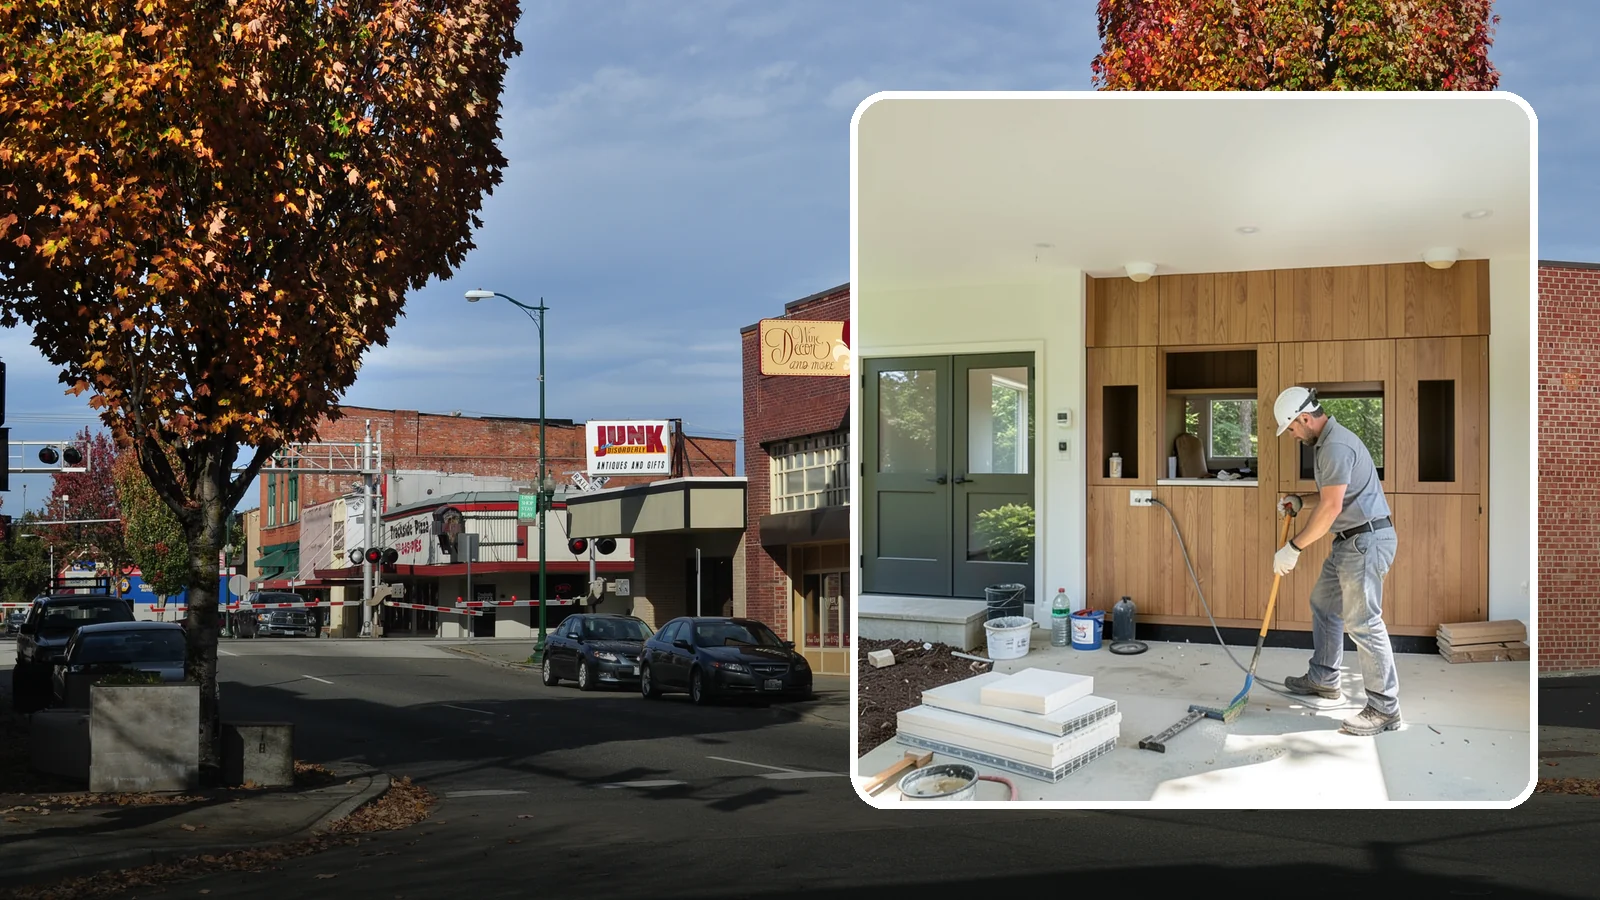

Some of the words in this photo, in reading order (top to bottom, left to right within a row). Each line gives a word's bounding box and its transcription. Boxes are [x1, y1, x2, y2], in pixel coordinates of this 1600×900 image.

[765, 327, 831, 365] Decor
[596, 425, 664, 457] JUNK
[607, 445, 646, 454] DISORDERLY
[597, 461, 628, 470] ANTIQUES
[631, 461, 644, 470] AND
[647, 460, 665, 470] GIFTS
[573, 473, 588, 491] RAIL
[390, 521, 412, 539] Trackside
[414, 519, 429, 535] Pizza
